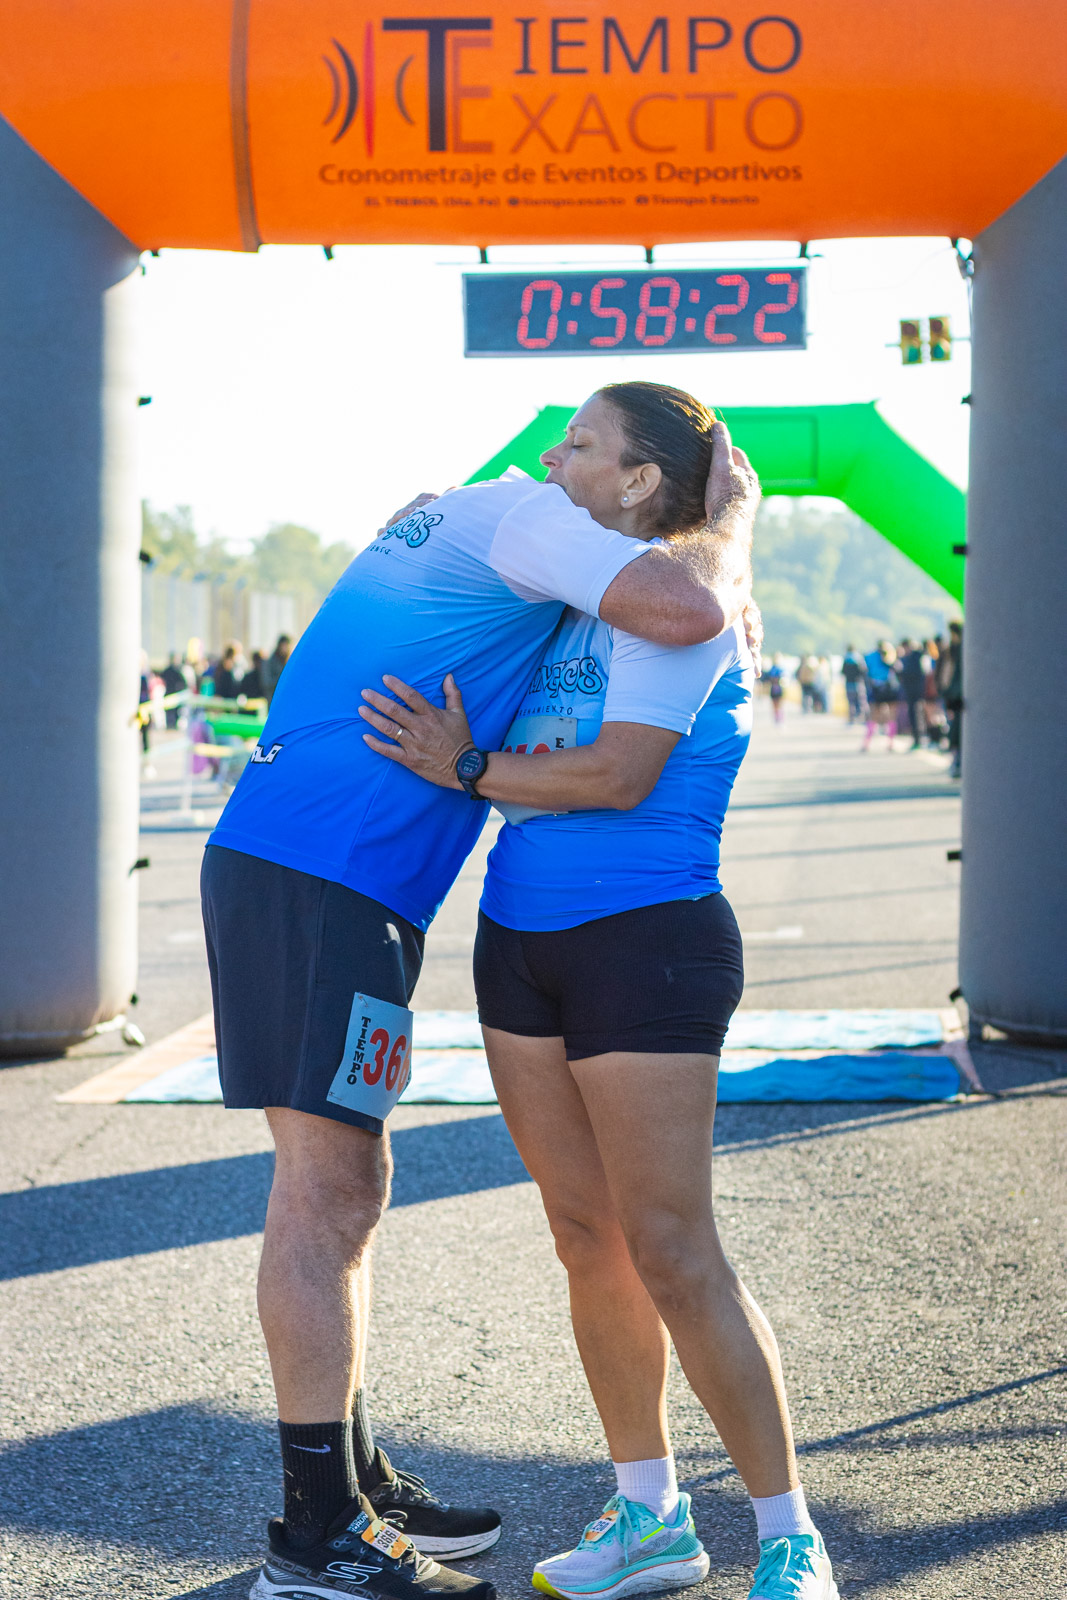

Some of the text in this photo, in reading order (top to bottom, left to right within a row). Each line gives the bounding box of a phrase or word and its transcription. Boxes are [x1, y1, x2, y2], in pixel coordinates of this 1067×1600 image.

[318, 161, 803, 188] Cronometraje de Eventos Deportivos
[516, 272, 799, 350] 0:58:22
[346, 1016, 371, 1086] TIEMPO
